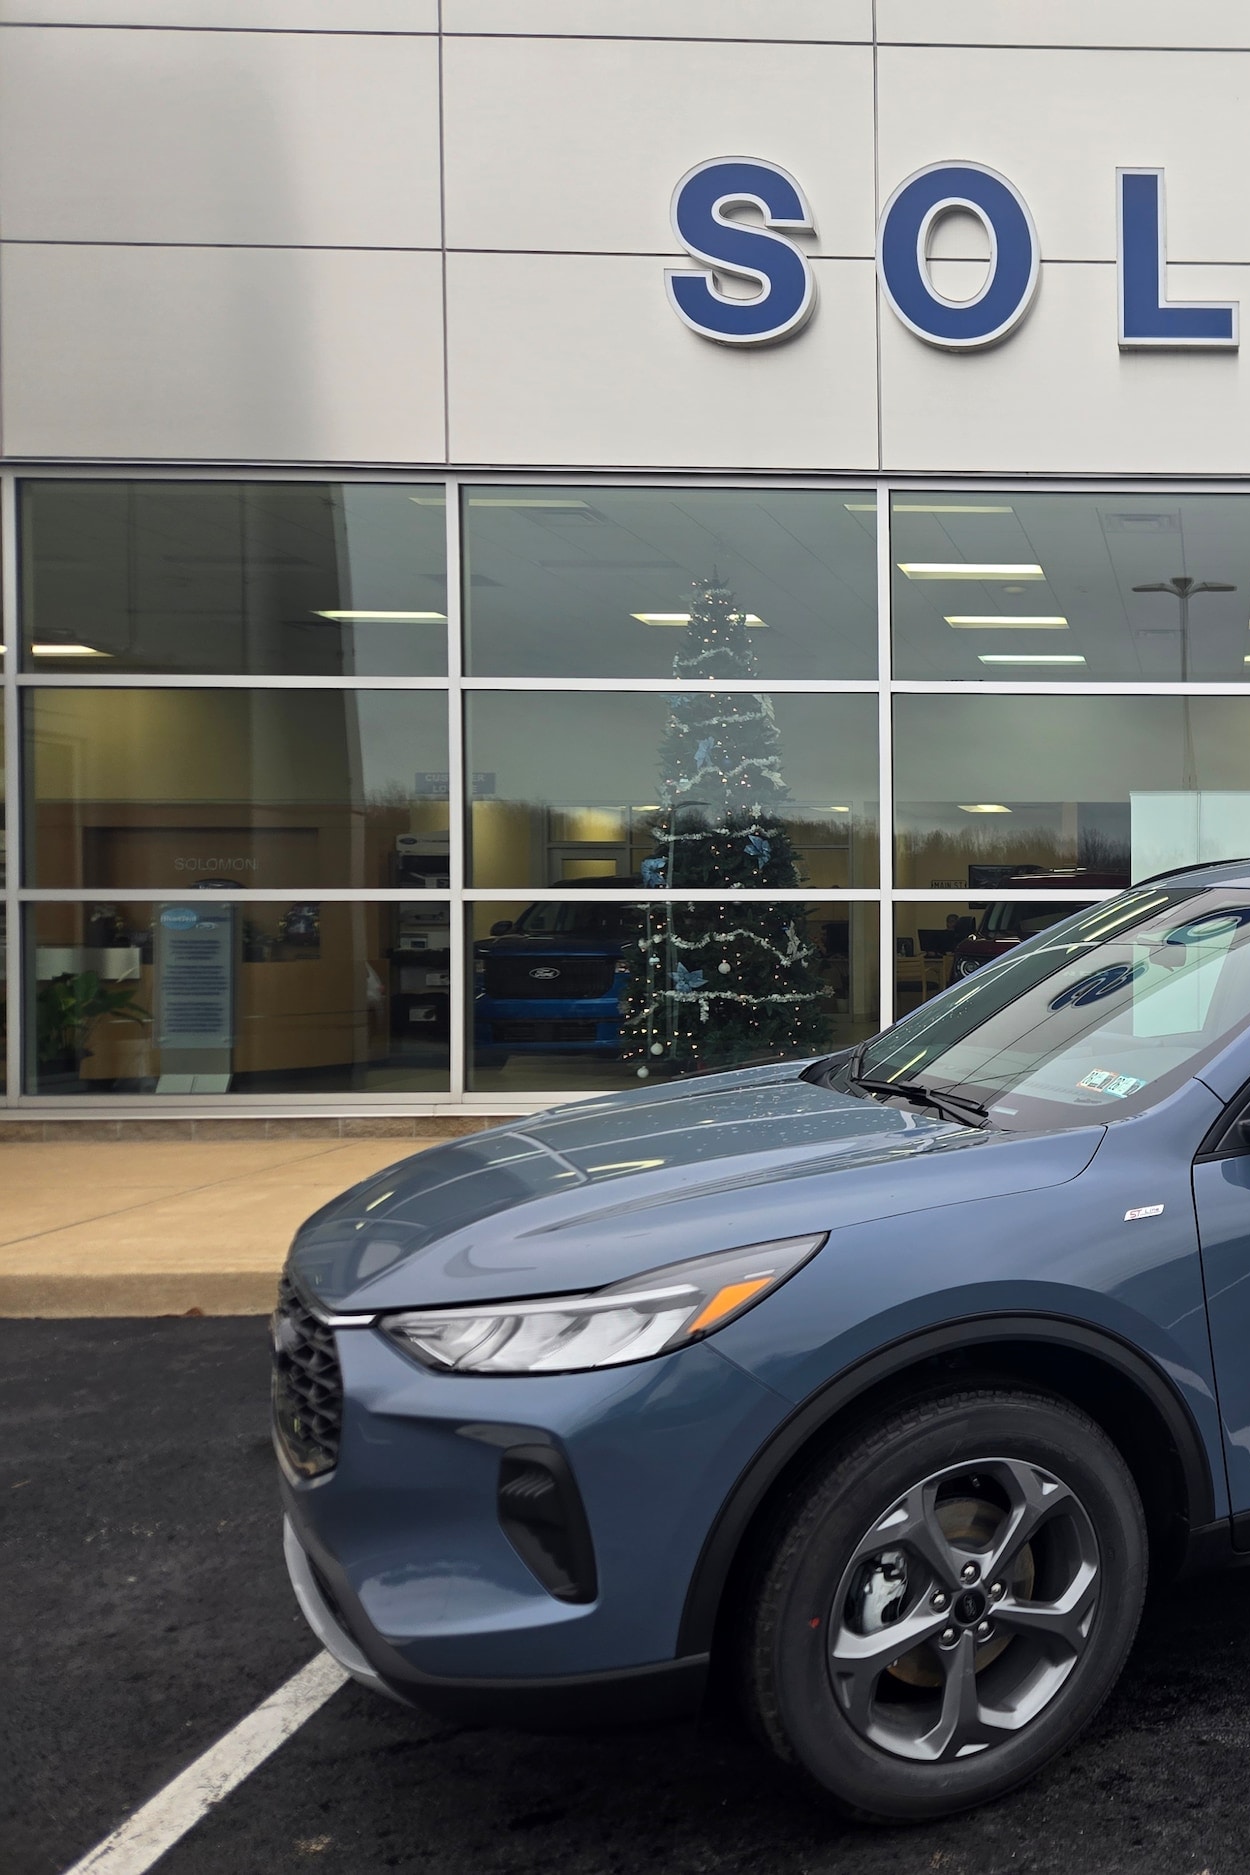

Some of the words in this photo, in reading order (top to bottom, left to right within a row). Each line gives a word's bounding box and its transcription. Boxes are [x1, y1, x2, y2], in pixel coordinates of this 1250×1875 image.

[425, 774, 485, 782] CUSER
[174, 858, 258, 871] SOLOMON
[934, 881, 951, 889] MAIN
